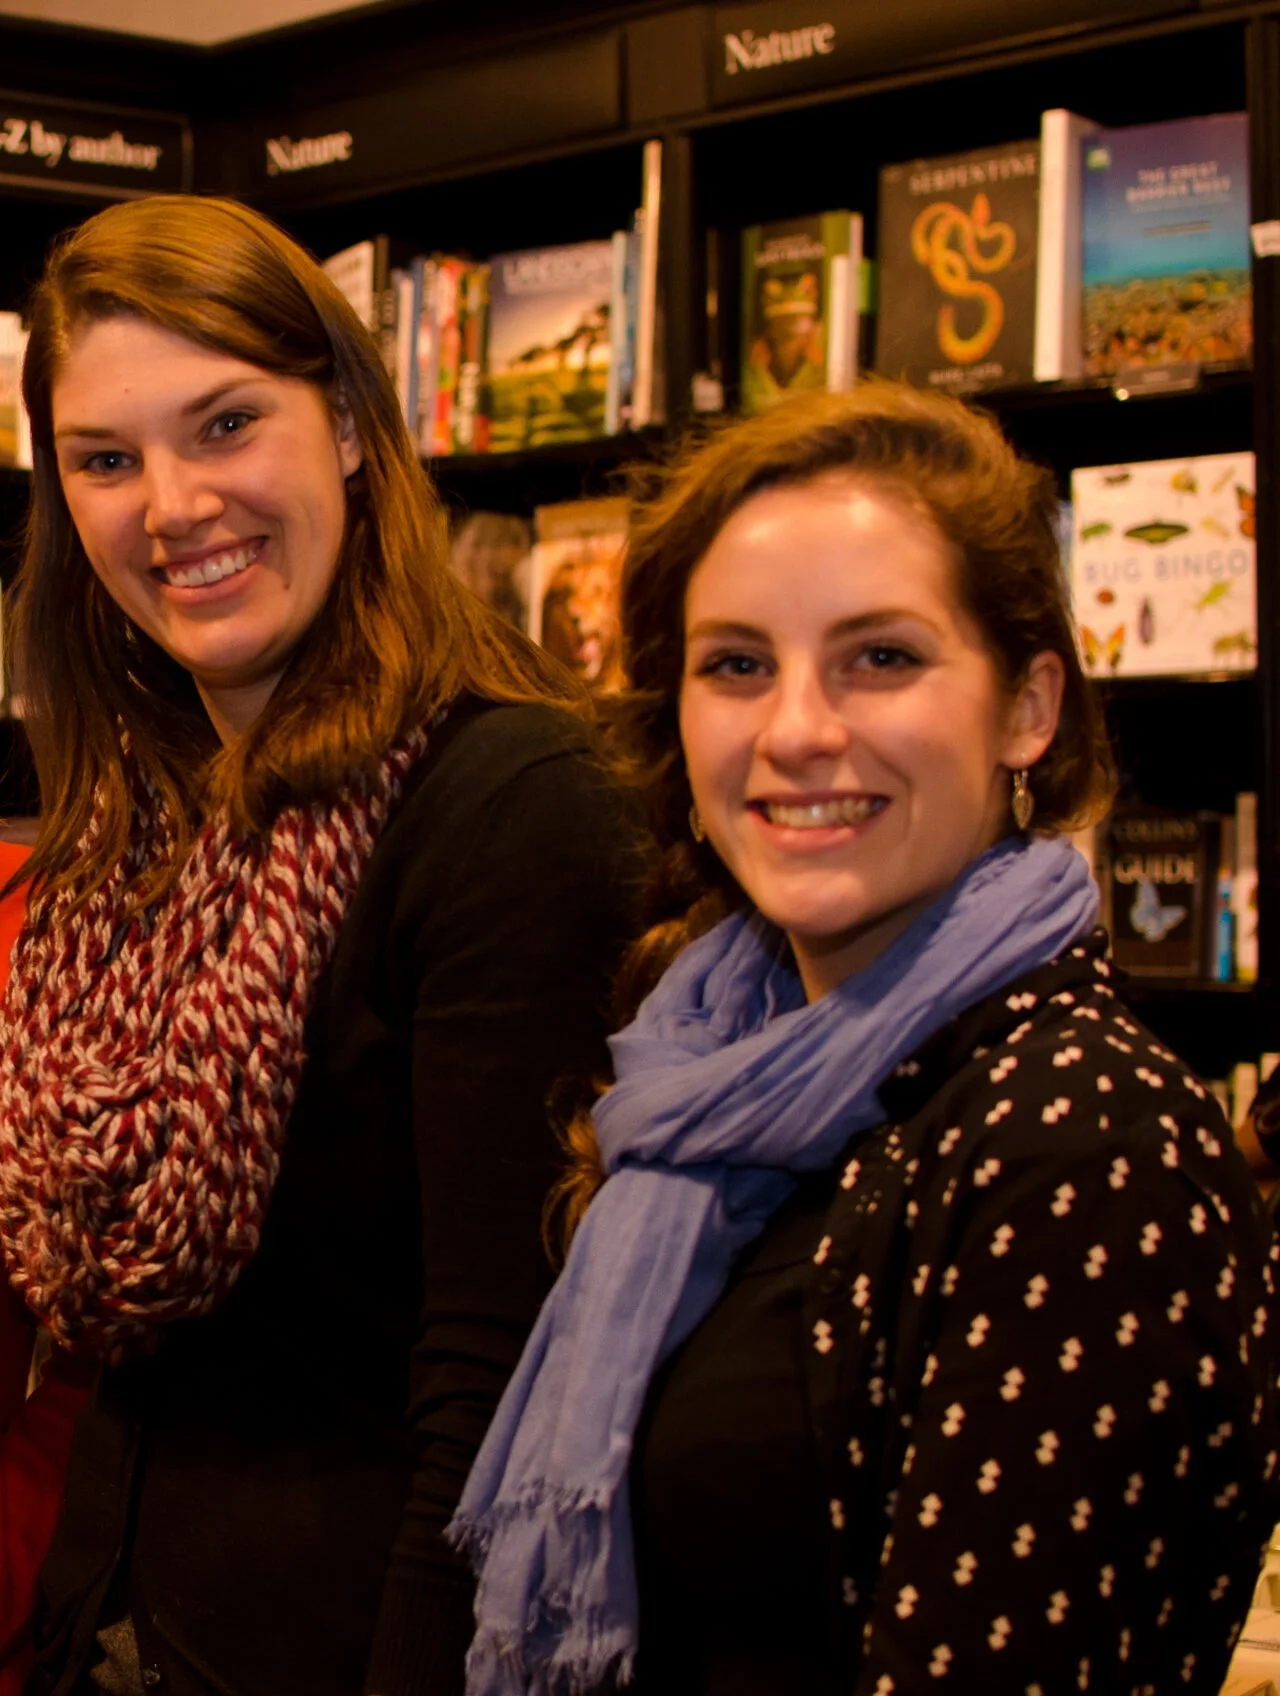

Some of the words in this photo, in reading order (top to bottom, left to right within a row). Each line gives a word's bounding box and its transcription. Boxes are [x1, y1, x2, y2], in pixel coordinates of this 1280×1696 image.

[724, 22, 835, 75] Nature
[30, 120, 67, 168] by
[68, 130, 162, 171] author
[266, 130, 354, 177] Nature
[1084, 557, 1141, 586] BUG
[1155, 548, 1250, 582] BINGO
[1113, 853, 1198, 885] GUIDE
